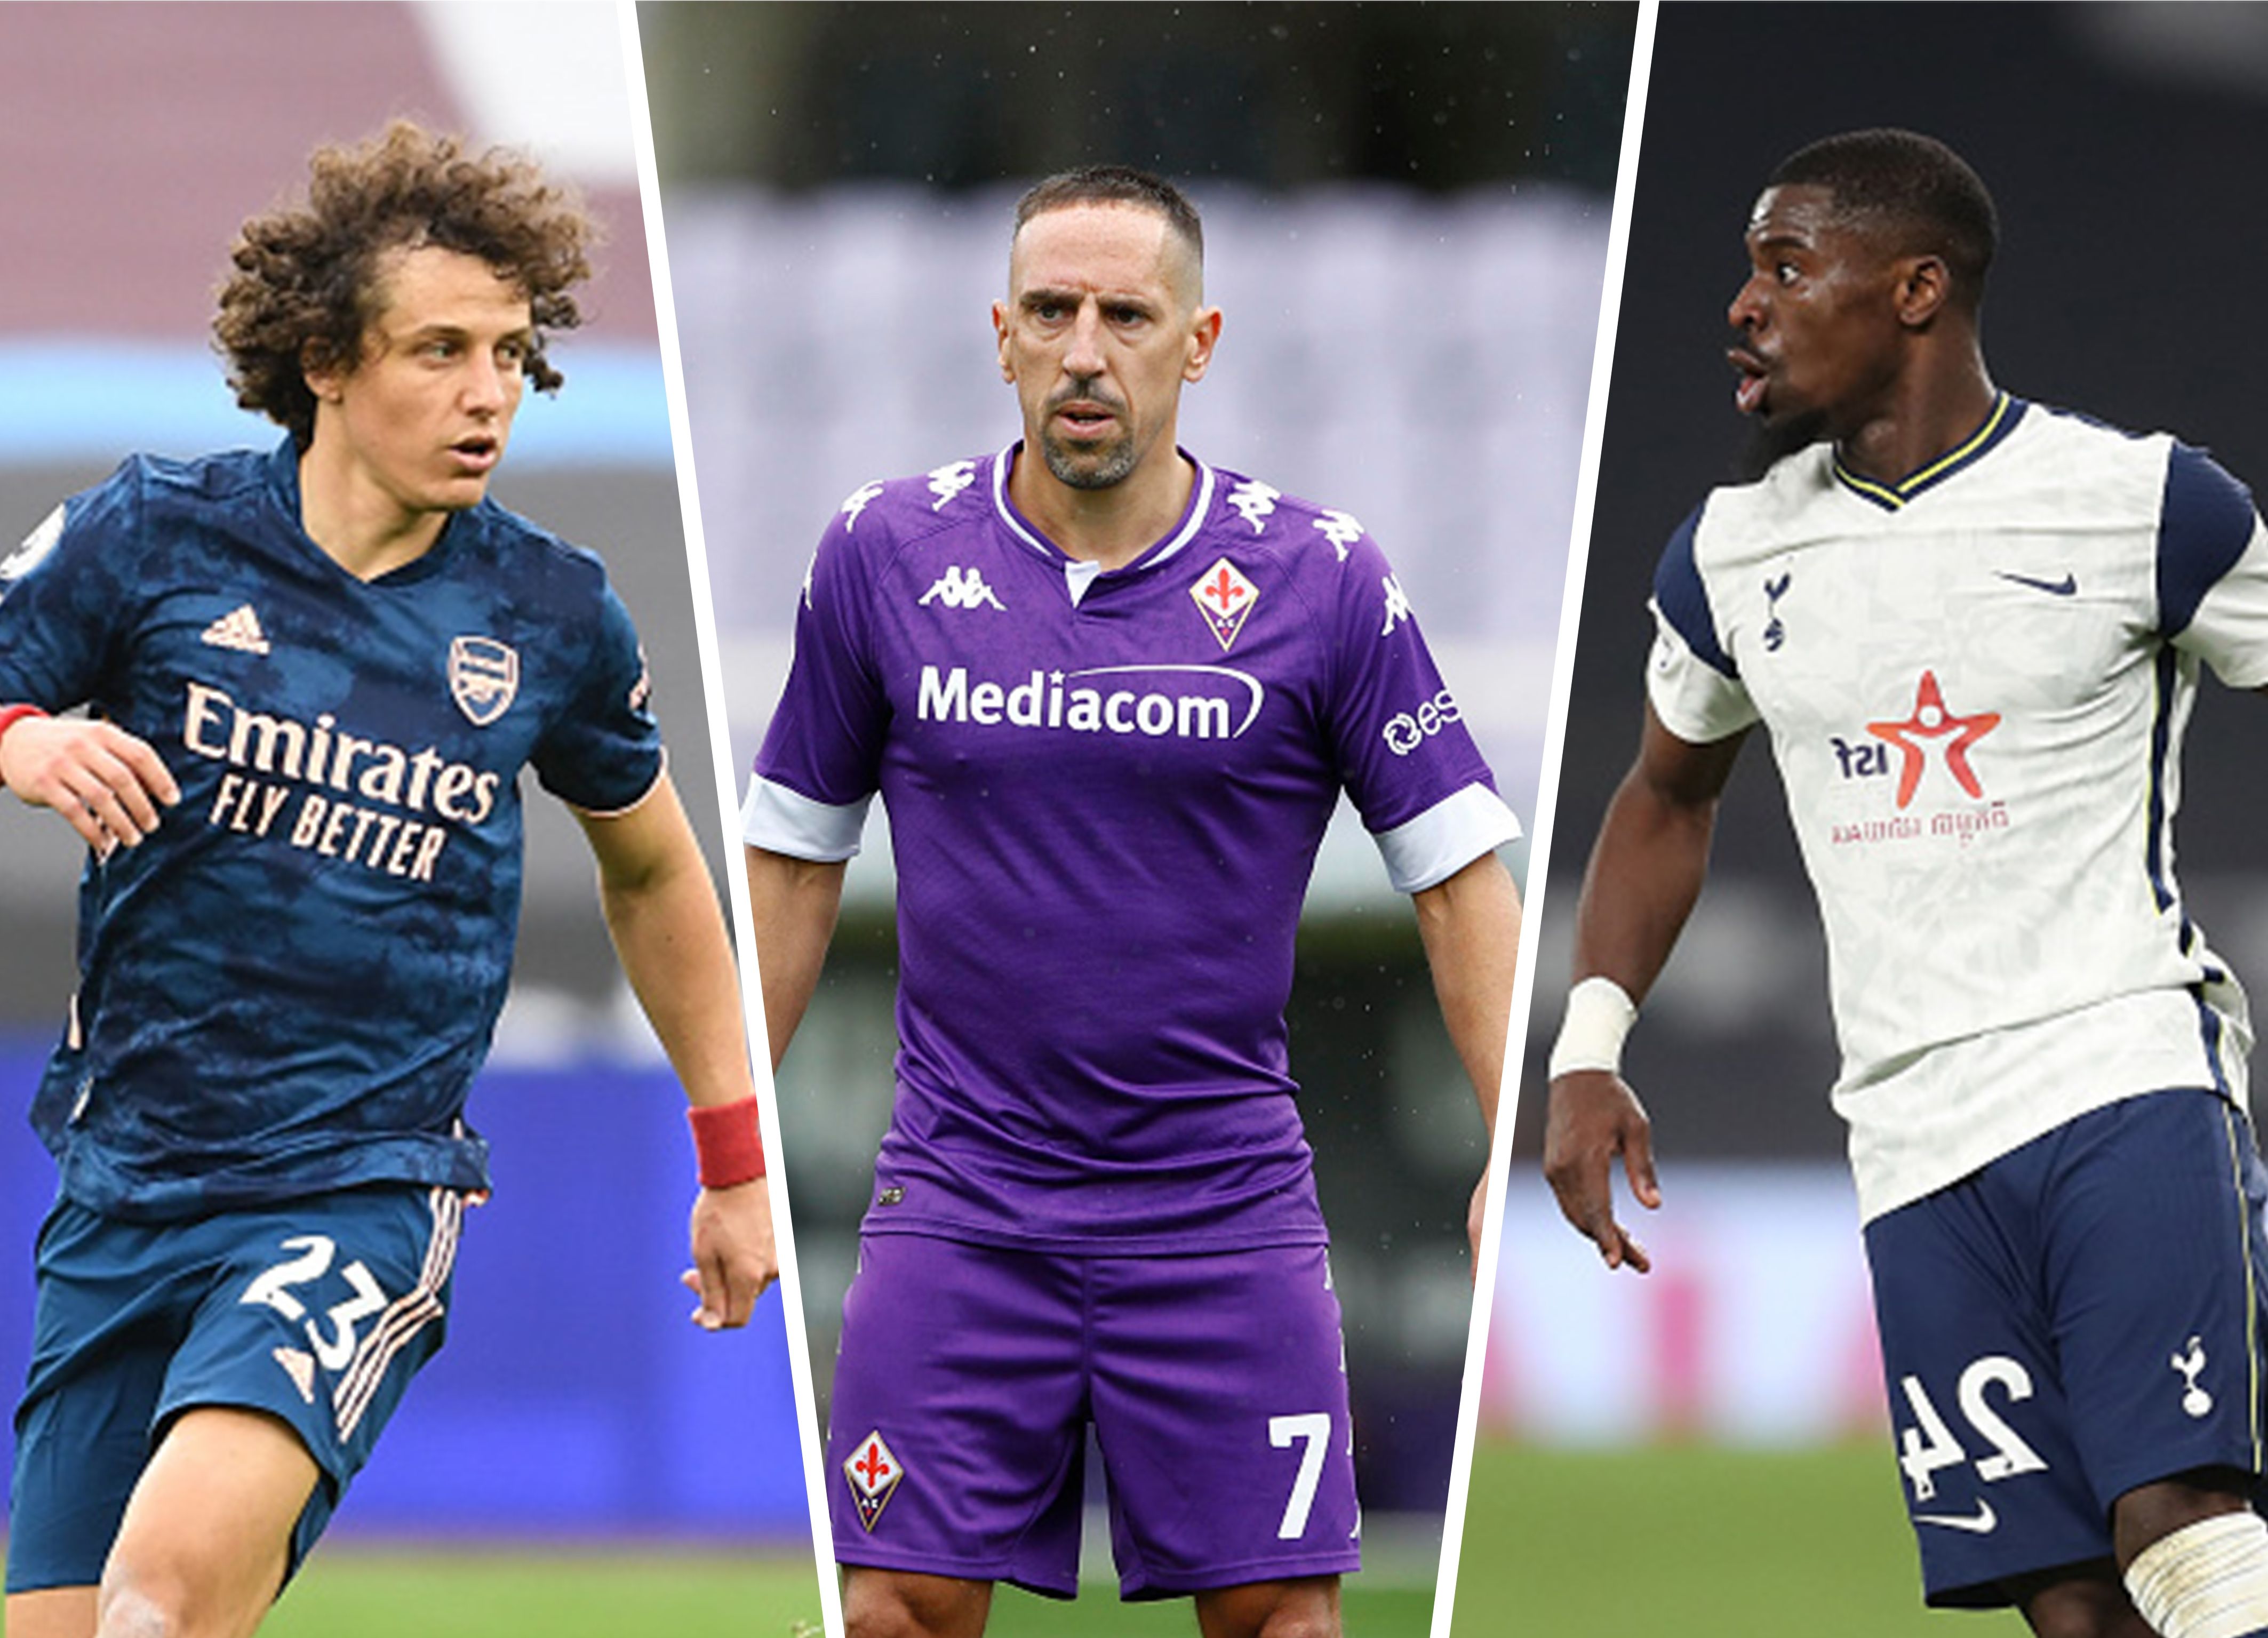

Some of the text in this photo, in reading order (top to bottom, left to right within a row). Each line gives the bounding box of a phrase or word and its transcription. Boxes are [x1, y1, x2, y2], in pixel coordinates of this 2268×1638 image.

[185, 681, 499, 826] Emirates
[917, 666, 1231, 740] Mediacom
[210, 773, 448, 883] FLY BETTER
[239, 1235, 389, 1371] 23
[1268, 1413, 1331, 1539] 7
